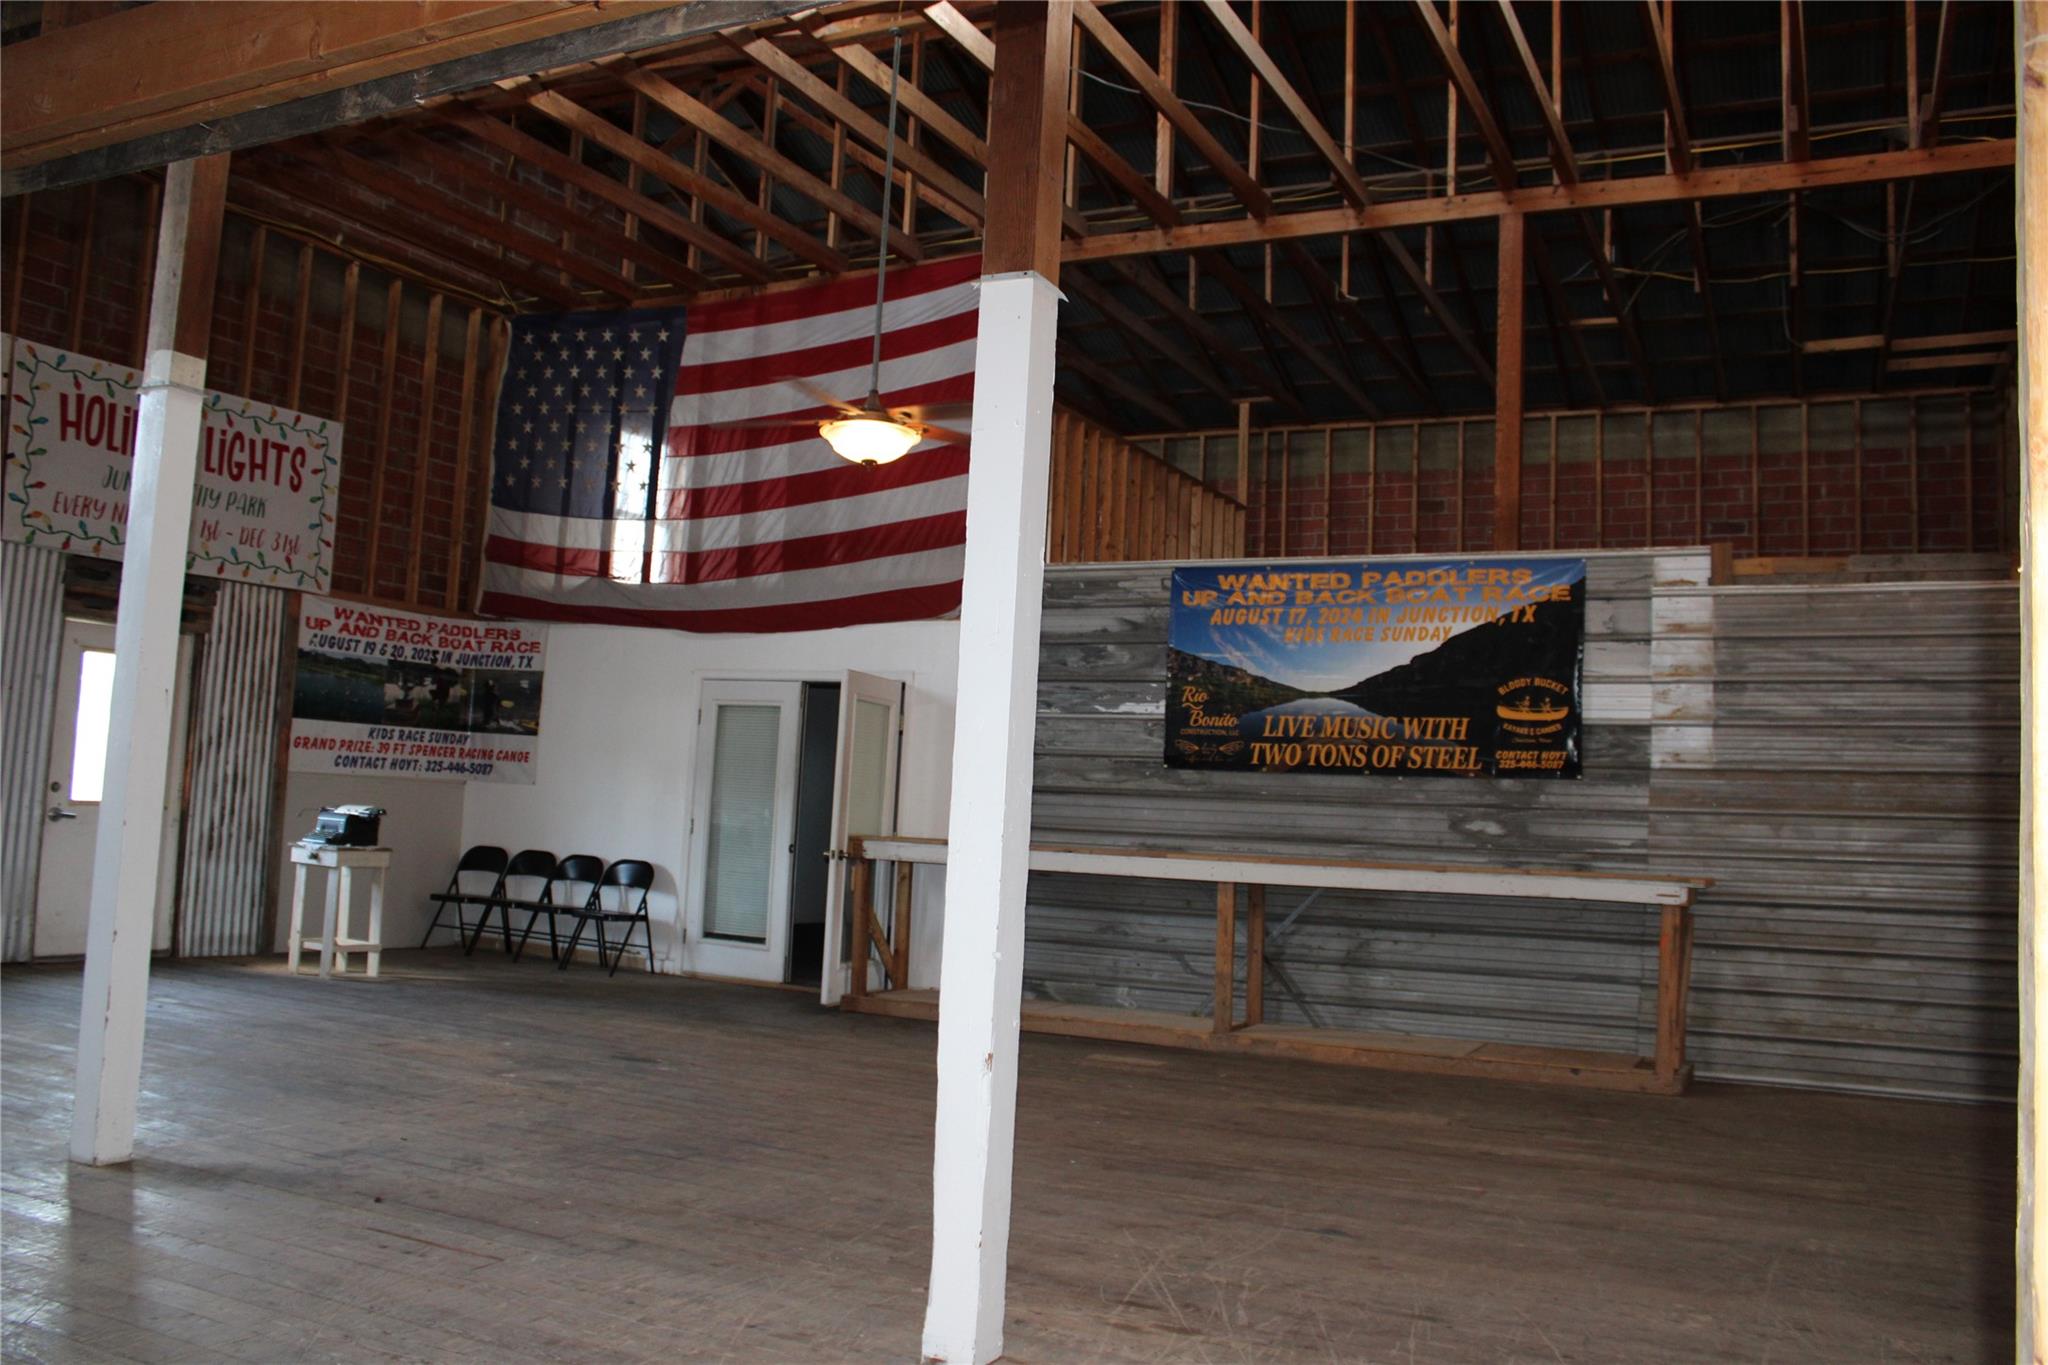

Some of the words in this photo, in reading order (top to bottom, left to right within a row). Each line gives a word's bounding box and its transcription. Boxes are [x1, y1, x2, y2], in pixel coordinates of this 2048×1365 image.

[224, 490, 267, 518] PARK
[52, 491, 107, 520] EVERY
[239, 526, 264, 548] DEC
[1217, 573, 1352, 591] WANTED
[1361, 568, 1533, 588] PADDLERS
[1182, 590, 1218, 606] UP
[1226, 590, 1287, 606] AND
[1295, 589, 1377, 605] BACK
[1386, 586, 1473, 604] BOAT
[1481, 584, 1572, 602] RACE
[334, 606, 421, 631] WANTED
[427, 621, 521, 640] PADDLERS
[1210, 607, 1285, 625] AUGUST
[1368, 607, 1391, 624] IN
[1396, 605, 1506, 626] JUNCTION,
[1511, 604, 1537, 623] TX
[305, 616, 332, 631] UP
[338, 622, 380, 638] AND
[385, 628, 433, 646] BACK
[438, 636, 486, 652] BOAT
[490, 641, 541, 654] RACE
[1283, 627, 1325, 642] KIDS
[1330, 626, 1375, 641] RACE
[1380, 626, 1453, 642] SUNDAY
[309, 633, 361, 652] AUGUST
[363, 641, 377, 655] 19
[441, 651, 453, 663] IN
[455, 653, 515, 668] JUNCTION,
[519, 655, 534, 668] TX
[1181, 685, 1209, 703] Rio
[1497, 678, 1532, 695] BLOODY
[1189, 710, 1240, 727] Bonito
[1263, 715, 1316, 737] LIVE
[1320, 716, 1398, 739] MUSIC
[1402, 717, 1471, 740] WITH
[368, 727, 395, 740] KIDS
[398, 729, 425, 742] RACE
[428, 731, 470, 745] SUNDAY
[293, 735, 337, 750] GRAND
[338, 739, 374, 753] PRIZE:
[377, 742, 390, 753] 39
[393, 743, 406, 755] FT
[408, 744, 456, 758] SPENCER
[458, 747, 495, 760] RACING
[496, 750, 530, 763] CANOE
[1250, 743, 1303, 766] TWO
[1307, 744, 1368, 767] TONS
[1371, 745, 1405, 768] OF
[1407, 746, 1482, 769] STEEL
[1495, 750, 1540, 760] CONTACT
[1541, 751, 1569, 760] HOYT
[334, 754, 388, 770] CONTACT
[390, 758, 422, 771] HOYT:
